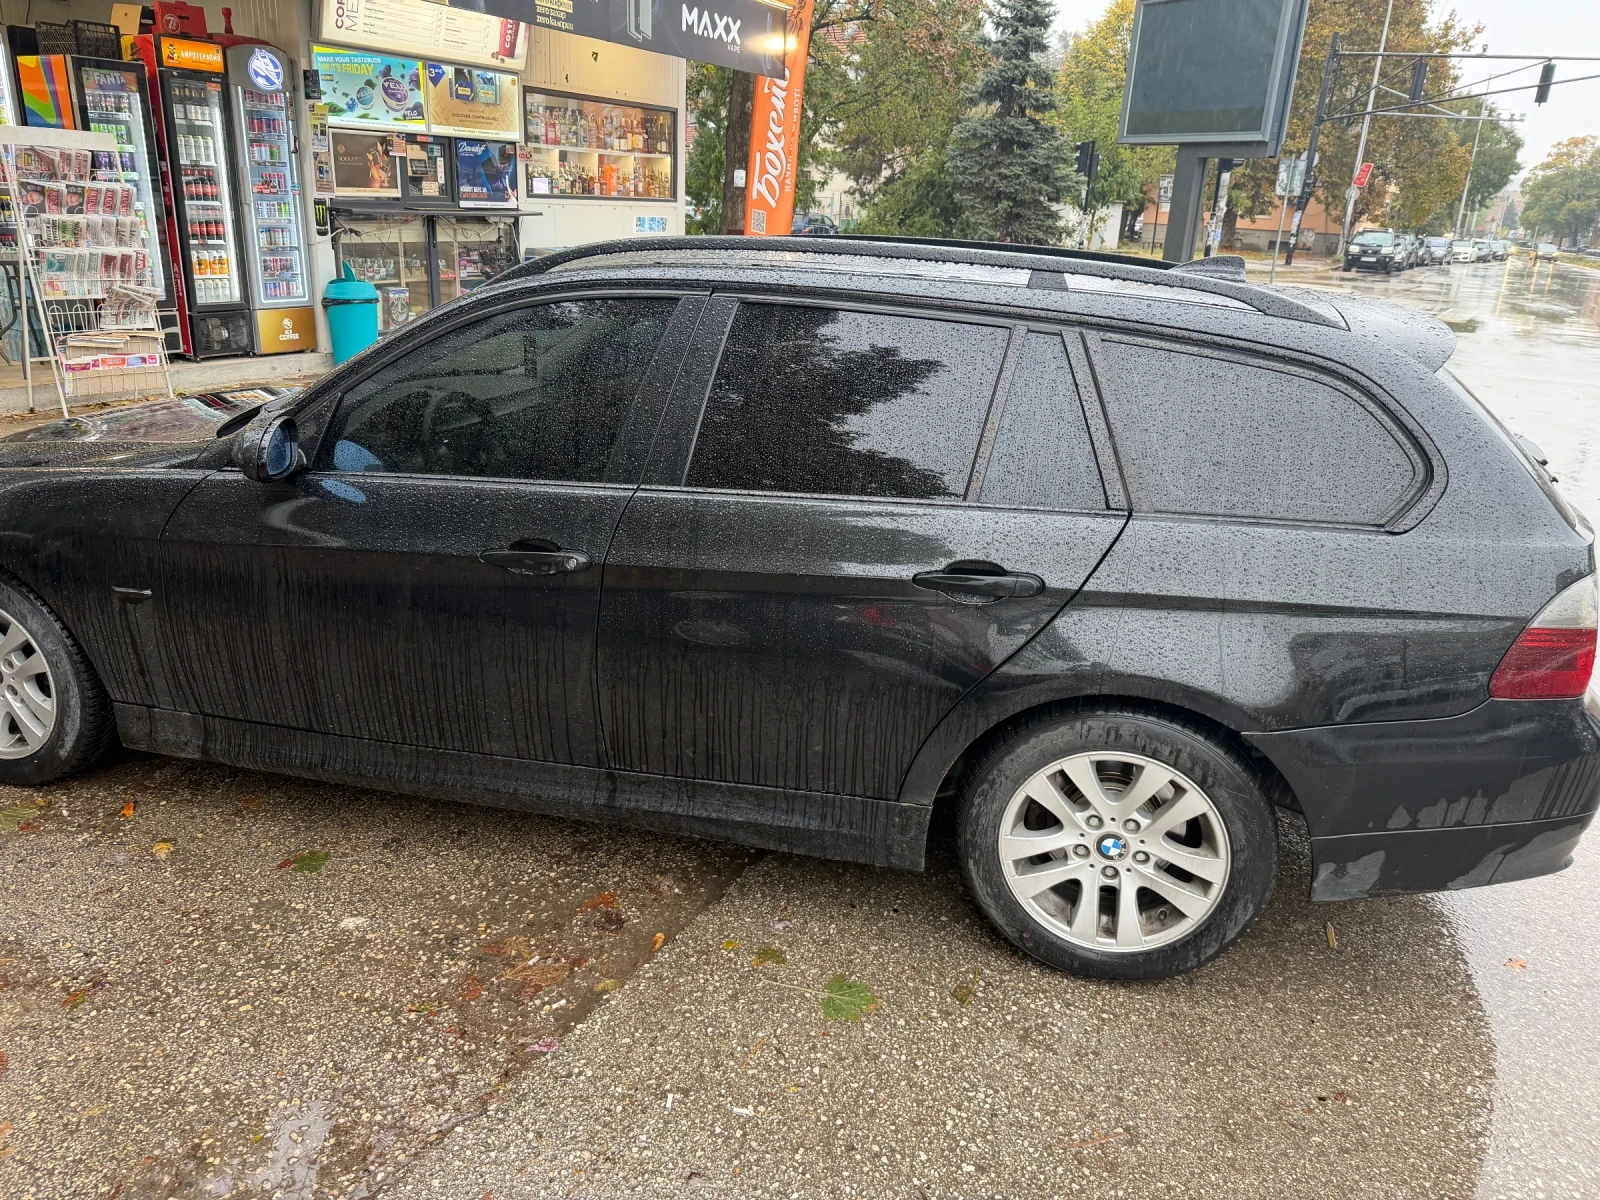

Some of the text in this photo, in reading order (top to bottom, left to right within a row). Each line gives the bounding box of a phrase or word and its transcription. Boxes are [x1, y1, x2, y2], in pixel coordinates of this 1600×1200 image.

[536, 5, 549, 15] zero
[536, 15, 549, 25] zero
[681, 3, 742, 45] MAXX
[727, 43, 741, 54] VAPE
[180, 49, 221, 63] БИРОТЕРАПИЯ
[343, 64, 375, 76] FRIDAY
[93, 71, 127, 85] FANTA
[382, 80, 407, 91] VELO
[458, 141, 486, 155] Davidoff
